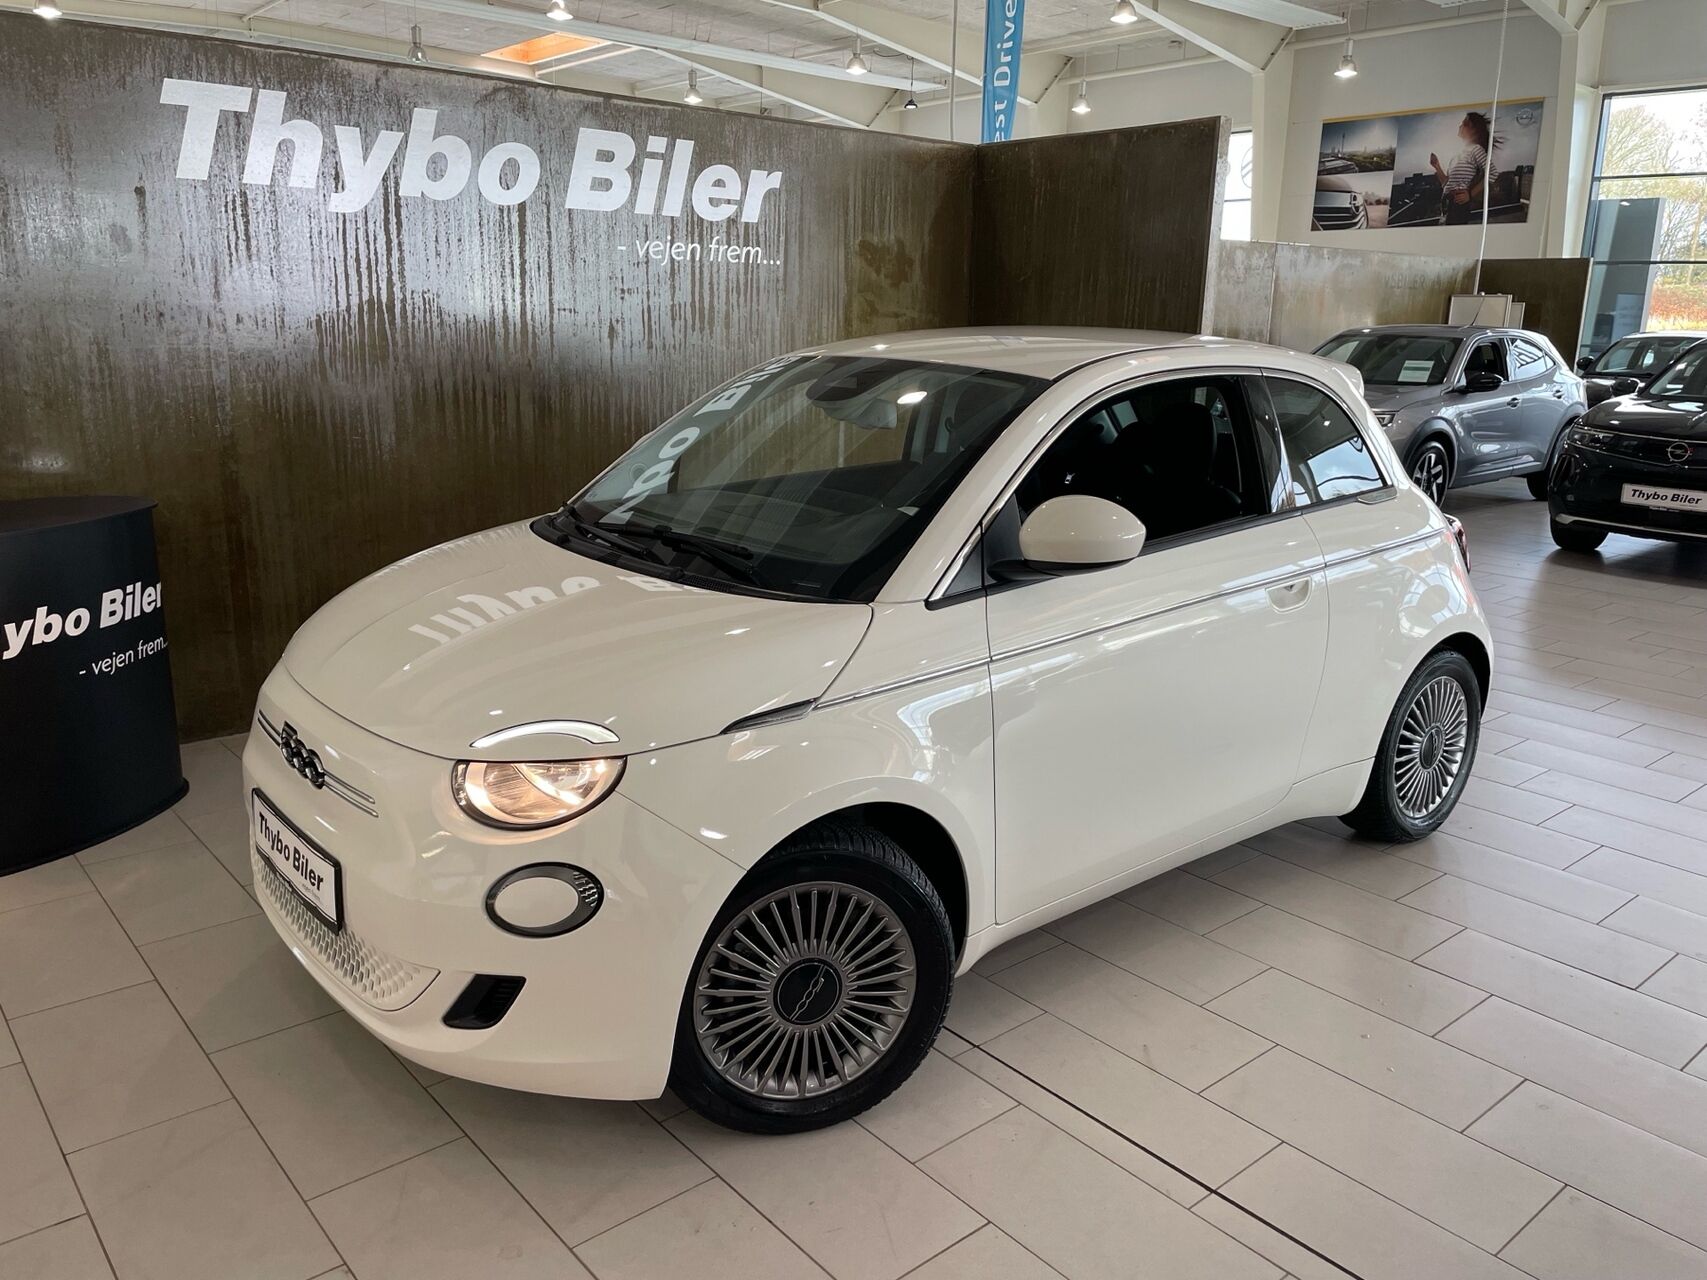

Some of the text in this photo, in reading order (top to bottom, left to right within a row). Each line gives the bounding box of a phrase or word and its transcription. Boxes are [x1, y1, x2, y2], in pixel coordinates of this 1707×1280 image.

[993, 0, 1018, 86] Drive
[159, 77, 783, 223] Thybo Biler
[635, 235, 701, 266] vejen
[708, 236, 781, 266] frem...
[1631, 488, 1703, 505] Thybo Biler
[2, 581, 162, 660] ybo Biler
[92, 650, 135, 676] vejen
[258, 811, 291, 862] Thybo
[292, 846, 324, 892] Biler
